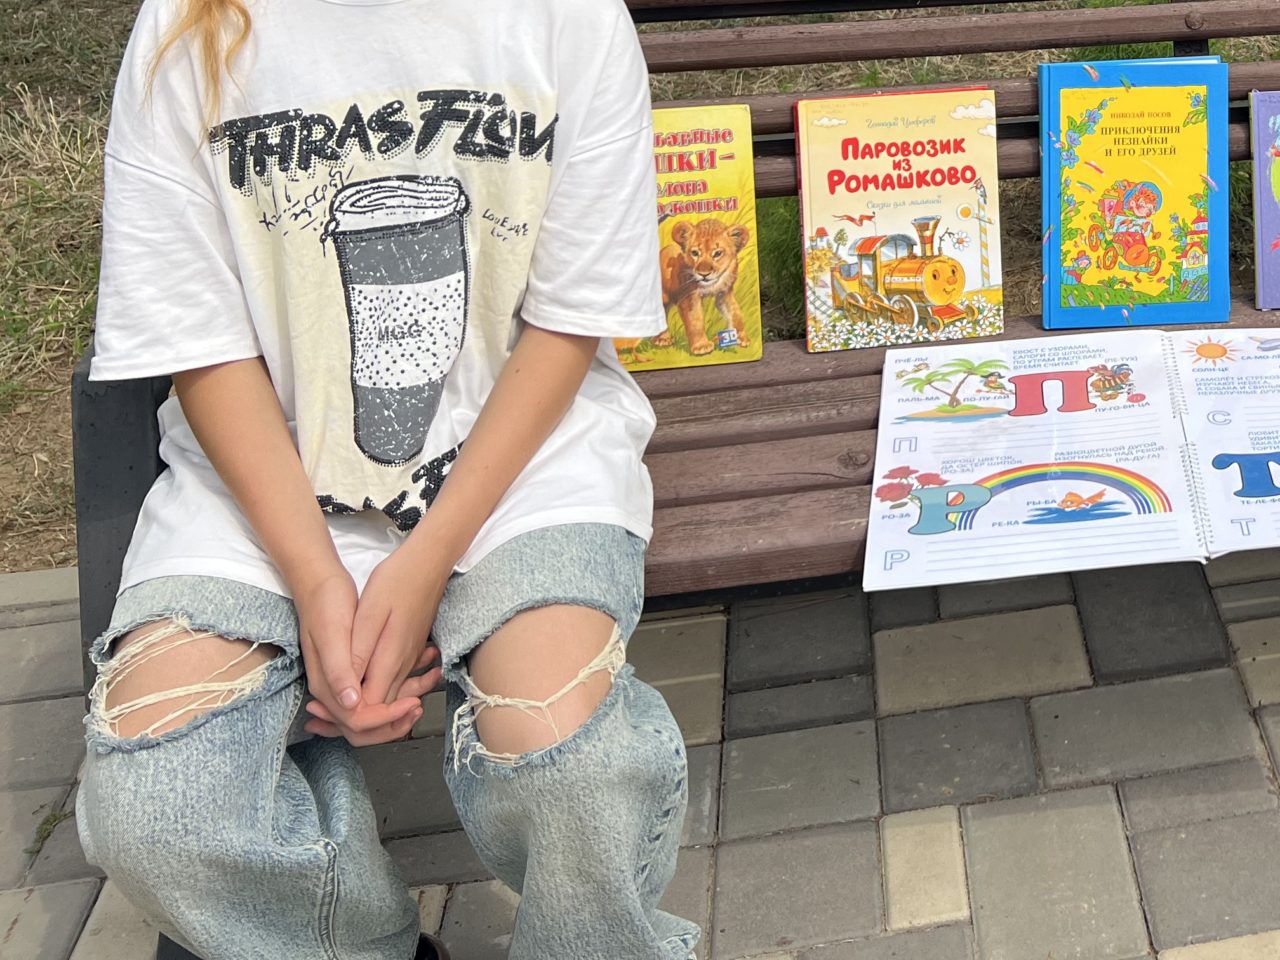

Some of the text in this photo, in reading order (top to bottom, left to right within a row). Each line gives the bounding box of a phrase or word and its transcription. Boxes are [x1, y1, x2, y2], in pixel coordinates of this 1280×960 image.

[1110, 111, 1146, 119] НИКОЛАЙ
[1100, 125, 1181, 136] ПРИКЛЮЧЕНИЯ
[1113, 135, 1169, 146] НЕЗНАЙКИ
[841, 137, 966, 161] ПАРОВОЗИК
[1105, 145, 1177, 157] И ЕГО ДРУЗЕЙ
[827, 165, 977, 195] РОМАШКОВО
[1007, 370, 1097, 417] П
[892, 436, 918, 454] П
[907, 483, 992, 536] Р
[883, 549, 911, 571] Р
